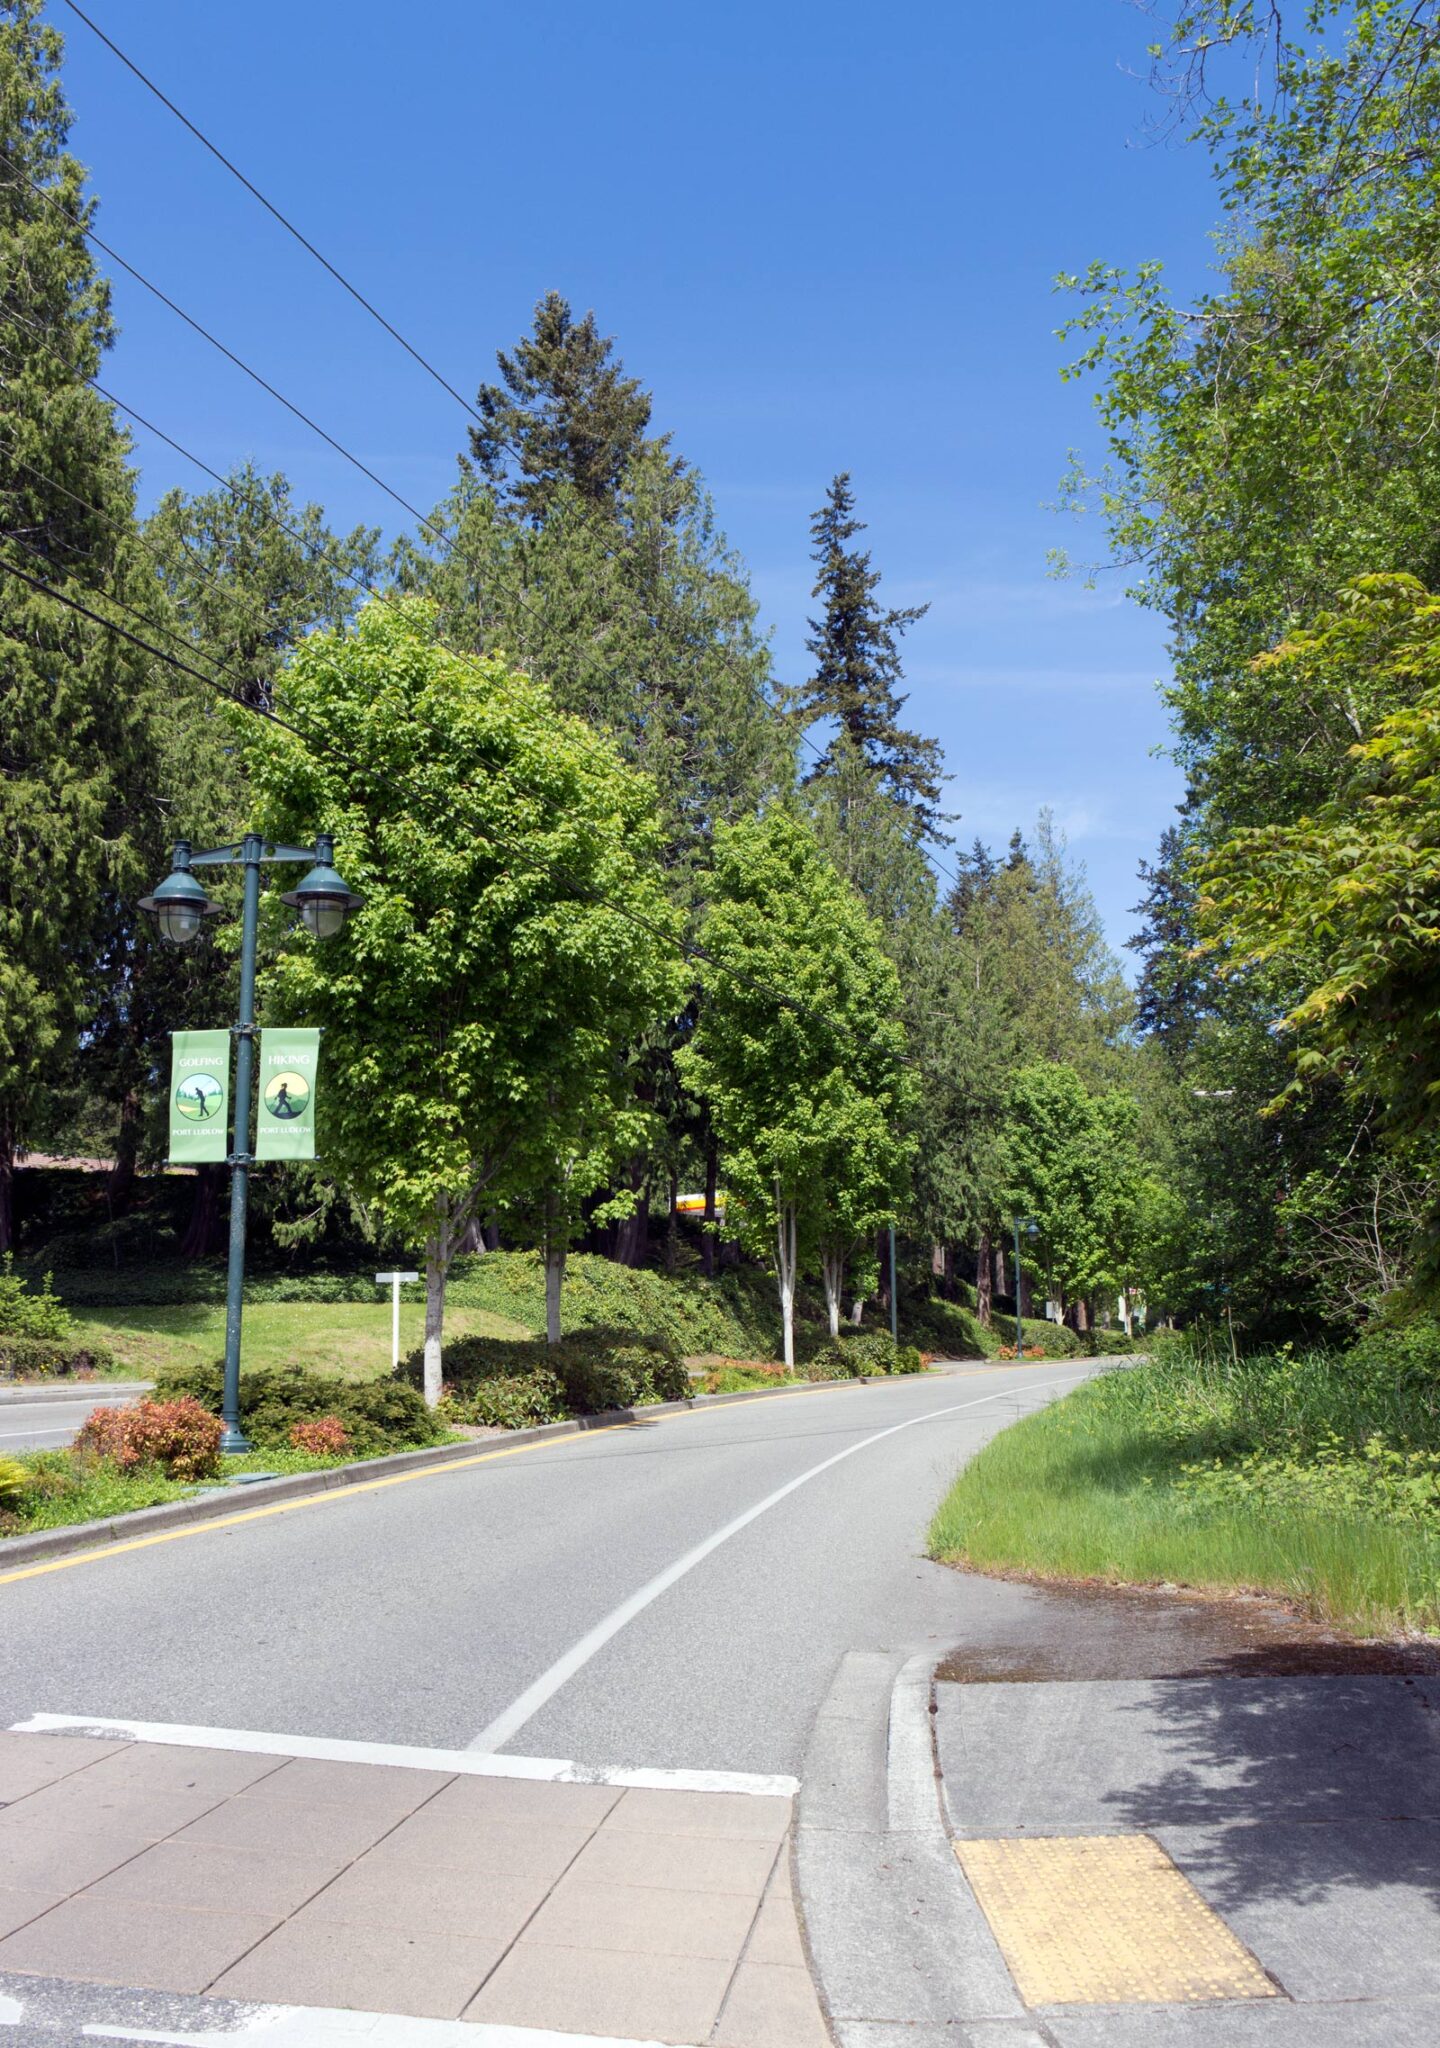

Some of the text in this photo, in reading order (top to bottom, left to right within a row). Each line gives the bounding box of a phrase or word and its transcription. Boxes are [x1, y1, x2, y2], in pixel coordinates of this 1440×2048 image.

[179, 1056, 224, 1067] GOLFING
[268, 1055, 311, 1065] HIKING
[172, 1128, 224, 1136] PORT LUDLOW
[260, 1126, 312, 1134] PORT LUDLOW
